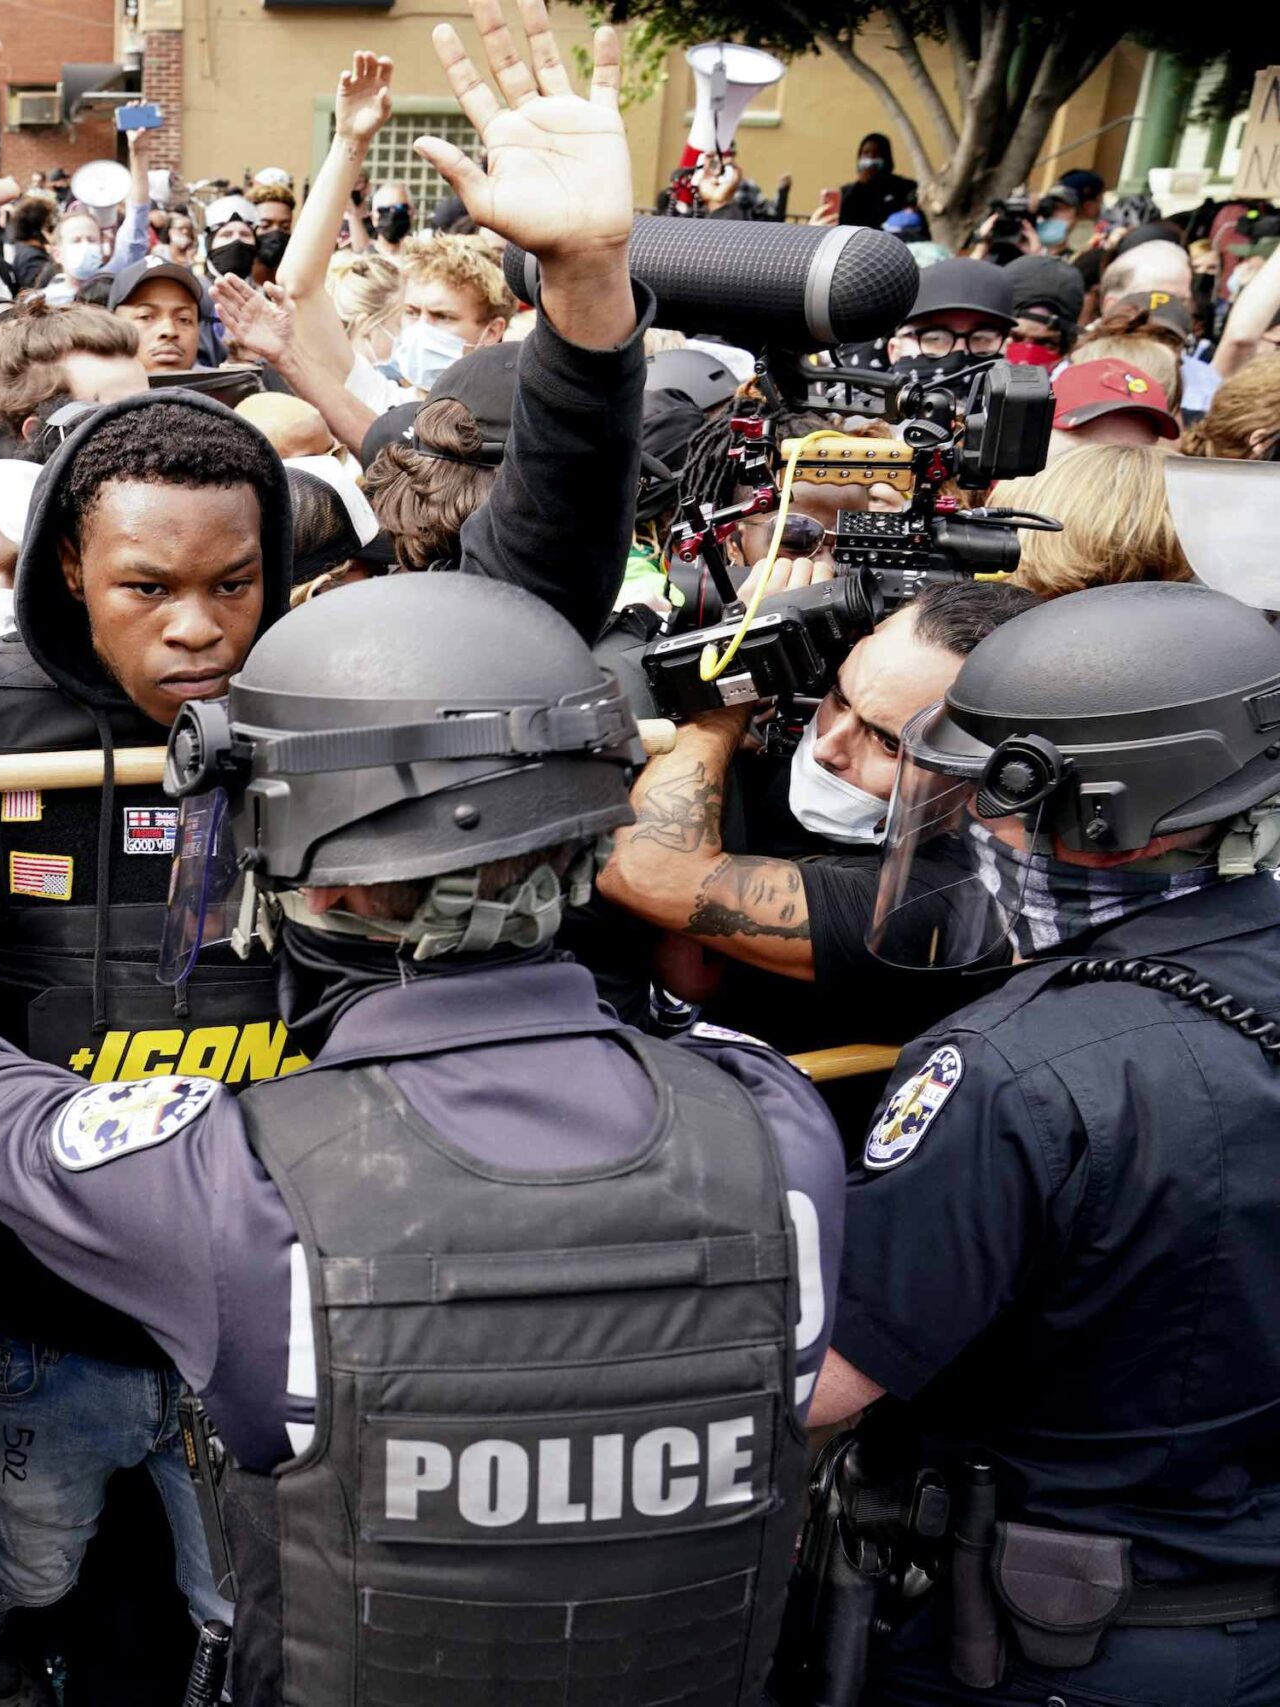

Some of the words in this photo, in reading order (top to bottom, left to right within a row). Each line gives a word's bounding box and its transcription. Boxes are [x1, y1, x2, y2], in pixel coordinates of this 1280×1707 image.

[127, 839, 155, 851] GOOD
[2, 1424, 35, 1484] 502
[385, 1415, 755, 1528] POLICE
